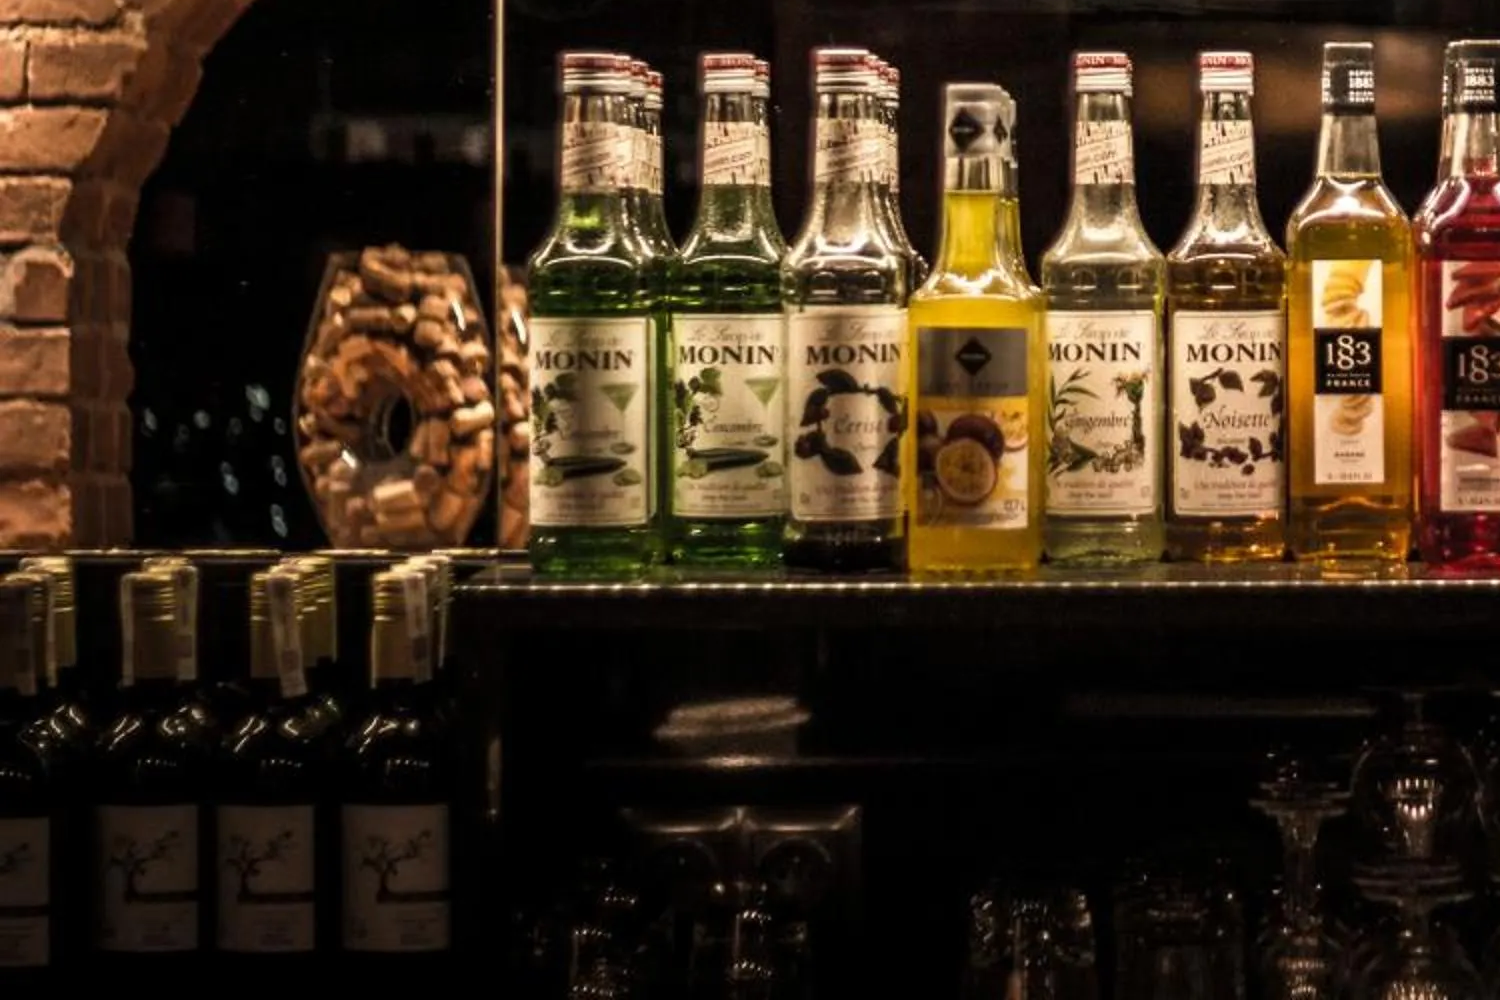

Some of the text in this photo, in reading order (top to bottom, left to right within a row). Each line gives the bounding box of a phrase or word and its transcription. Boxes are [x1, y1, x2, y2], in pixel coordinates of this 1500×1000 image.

[535, 348, 634, 371] MONIN
[679, 343, 775, 366] MONIN
[805, 343, 902, 366] MONIN
[1047, 340, 1142, 363] MONIN
[1186, 341, 1282, 364] MONIN
[1326, 378, 1372, 388] FRANCE
